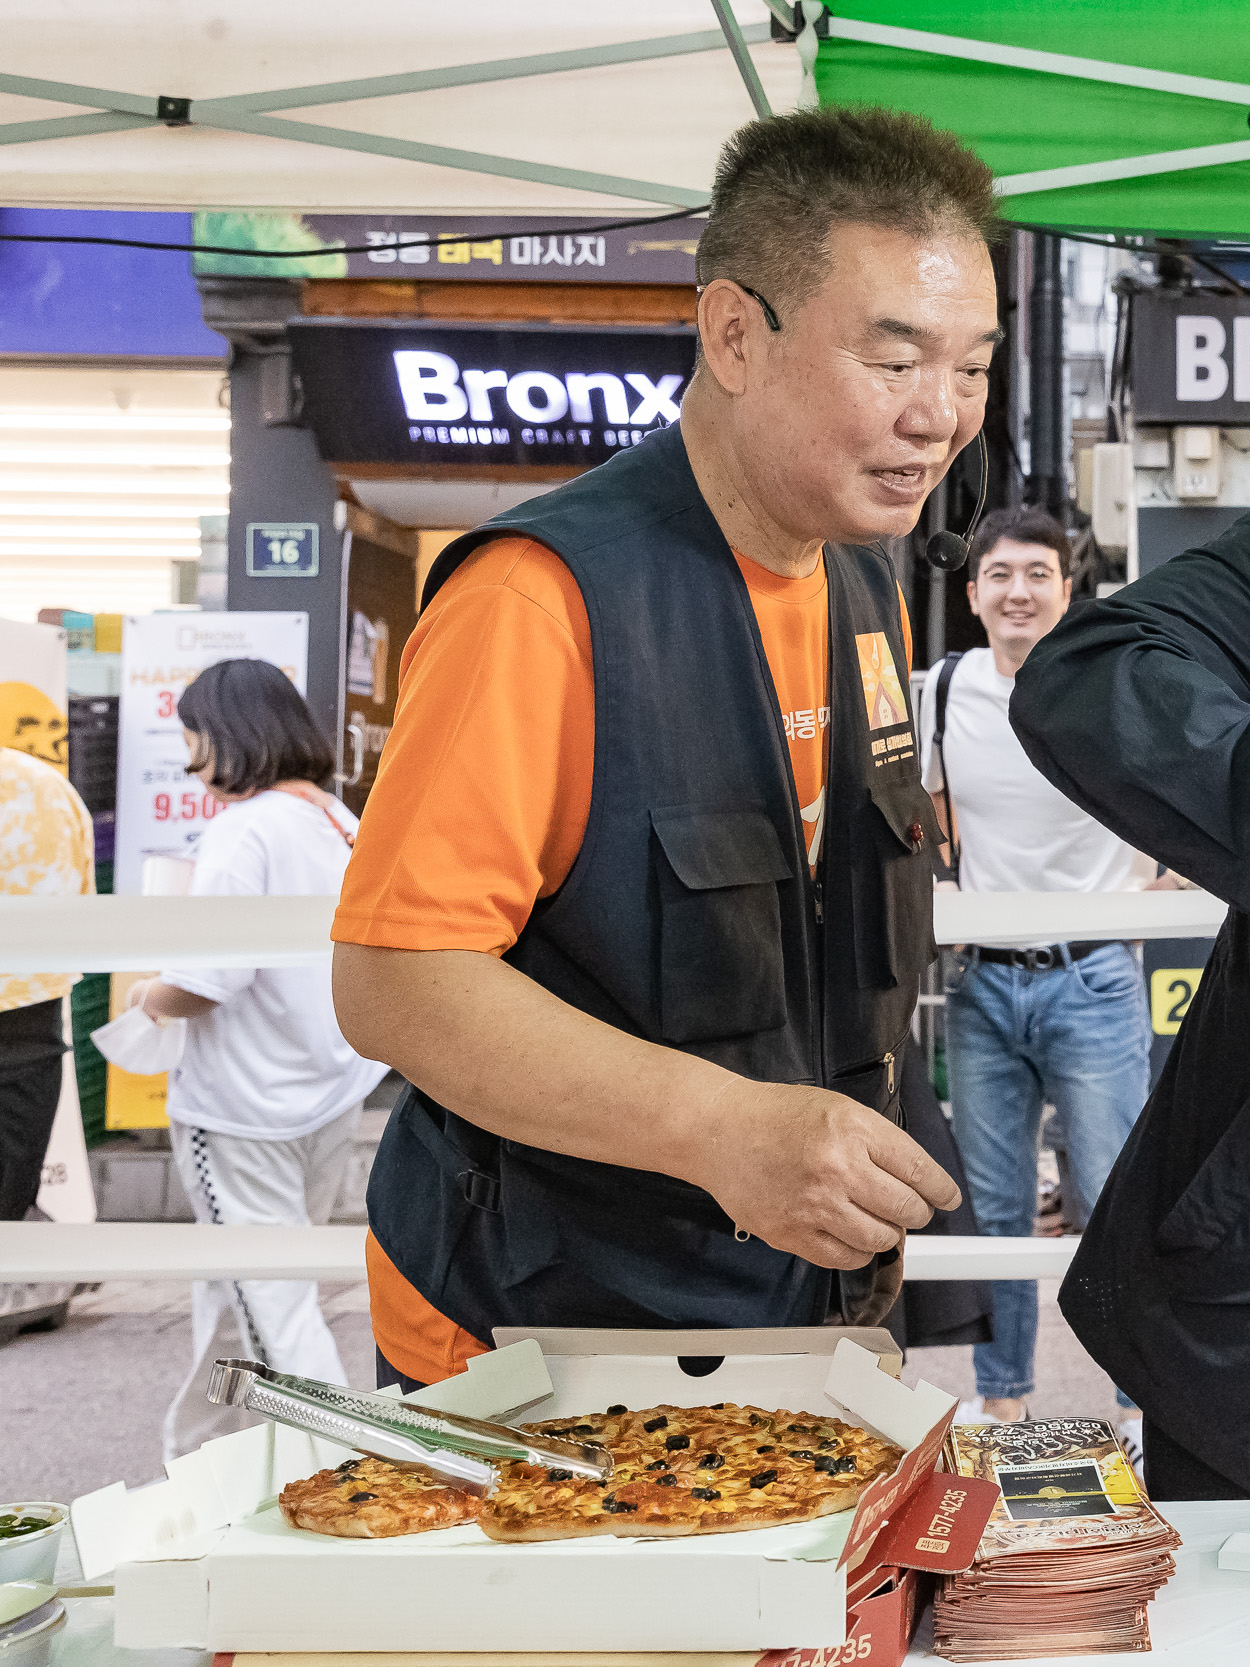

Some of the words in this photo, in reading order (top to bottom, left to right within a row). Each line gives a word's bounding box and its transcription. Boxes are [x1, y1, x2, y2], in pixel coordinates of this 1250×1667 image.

[510, 235, 606, 266] 마사지
[392, 350, 684, 424] Bronx
[408, 426, 510, 445] PREMIUM
[520, 428, 592, 446] CRAFT
[267, 540, 300, 564] 16
[154, 793, 228, 823] 9,50
[926, 1488, 968, 1537] 1577-4235
